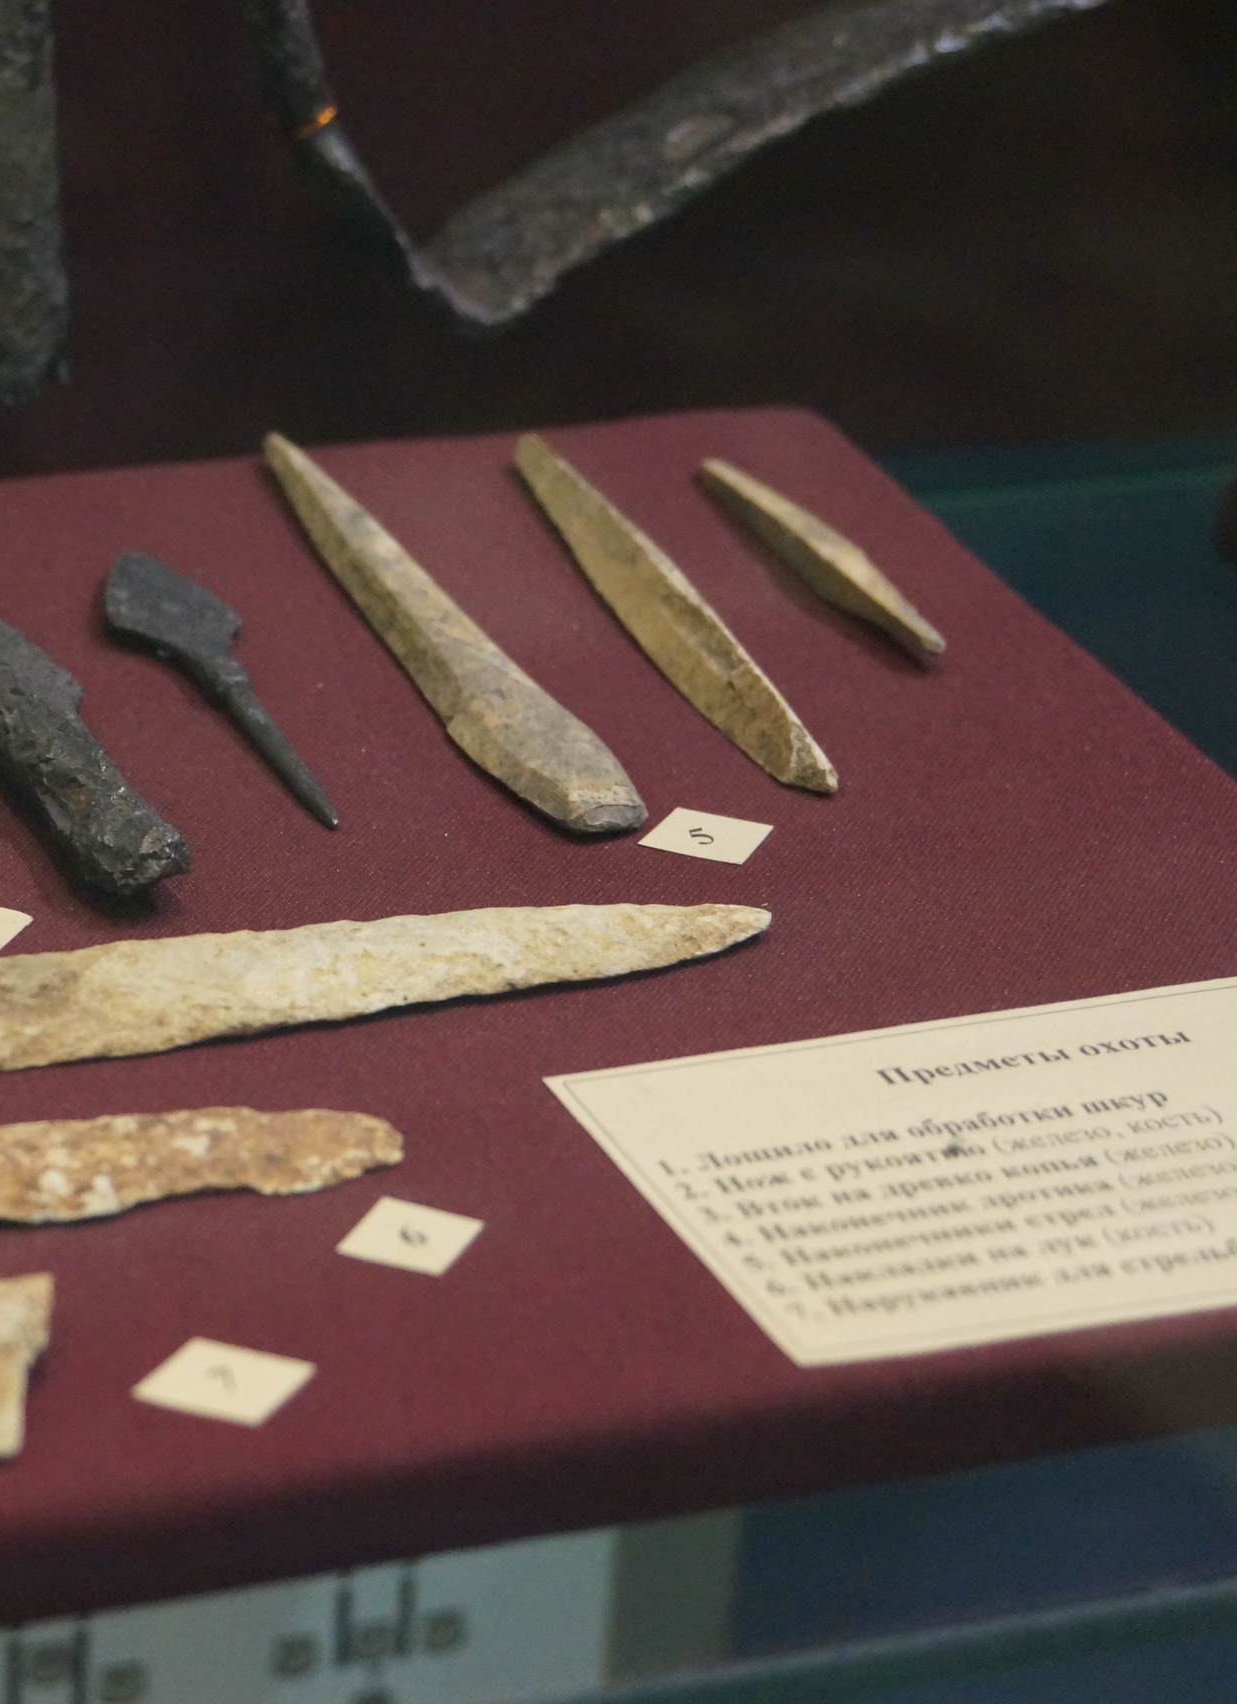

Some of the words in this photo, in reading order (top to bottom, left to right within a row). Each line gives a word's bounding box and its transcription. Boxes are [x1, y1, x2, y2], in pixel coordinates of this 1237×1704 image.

[688, 827, 715, 845] 5
[876, 1048, 1073, 1086] Предметы
[1079, 1029, 1195, 1058] охоты
[658, 1157, 691, 1177] 1.
[840, 1128, 901, 1151] для
[906, 1103, 1076, 1142] обработки
[1080, 1088, 1170, 1118] шкур
[674, 1180, 711, 1201] 2.
[714, 1171, 793, 1195] Нож
[797, 1165, 818, 1183] с
[1126, 1104, 1224, 1135] кость)
[699, 1204, 733, 1223] 3.
[830, 1187, 872, 1206] на
[880, 1170, 994, 1200] древко
[1000, 1153, 1100, 1181] копья
[1103, 1130, 1236, 1167] (железо)
[757, 1197, 975, 1244] Наконечник
[779, 1218, 1017, 1268] Наконечники
[1023, 1203, 1116, 1227] стрел
[985, 1244, 1029, 1265] на
